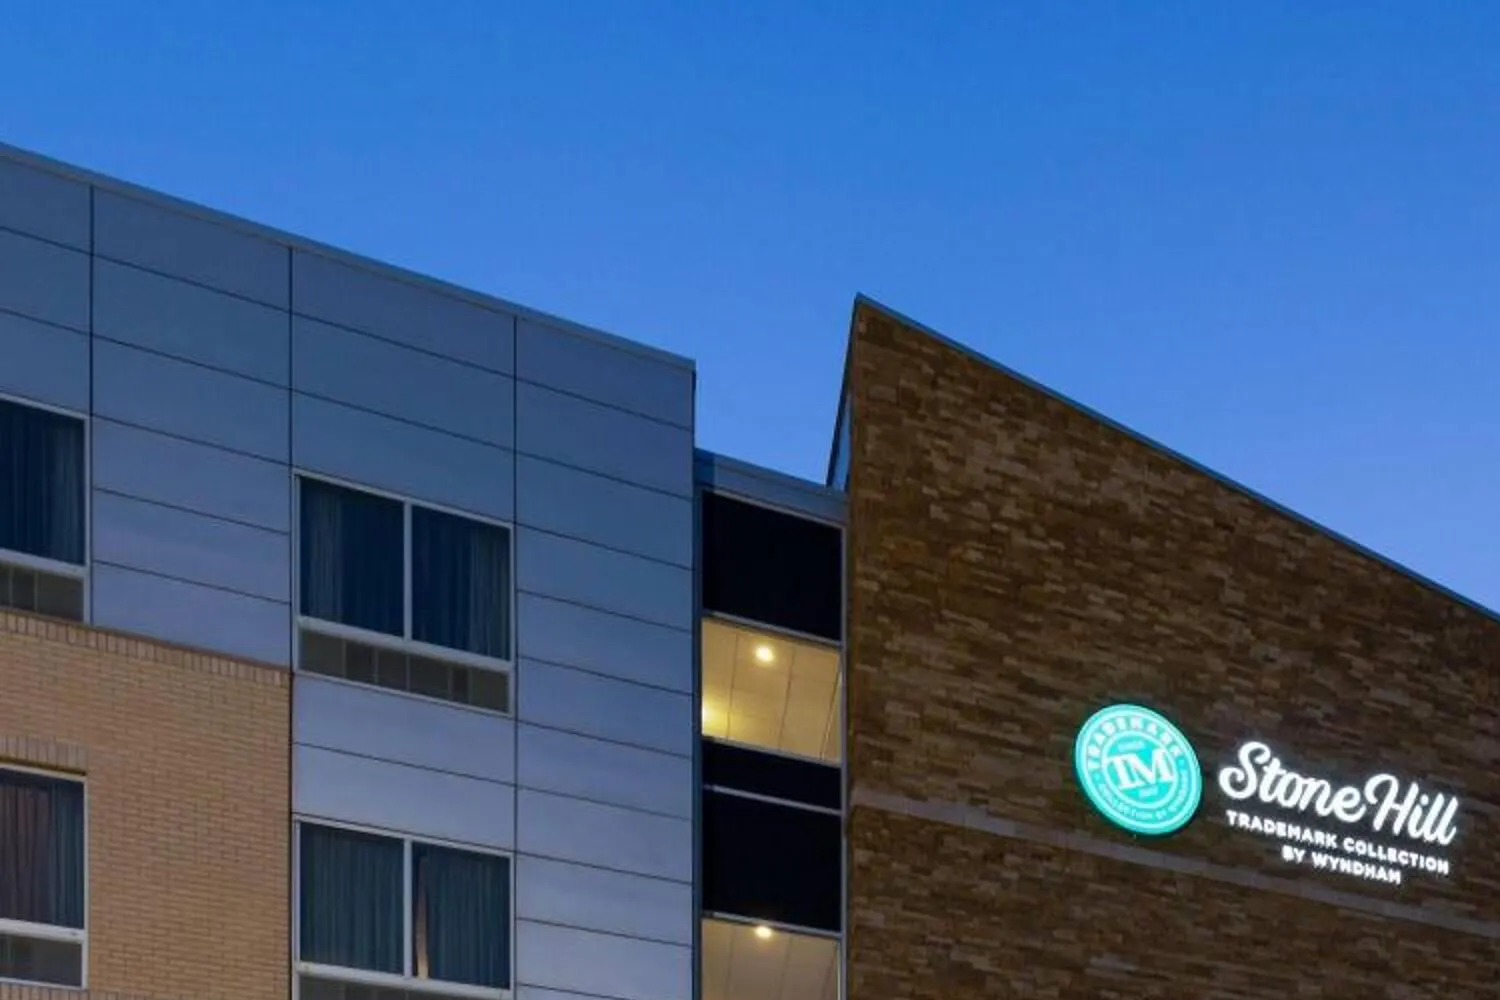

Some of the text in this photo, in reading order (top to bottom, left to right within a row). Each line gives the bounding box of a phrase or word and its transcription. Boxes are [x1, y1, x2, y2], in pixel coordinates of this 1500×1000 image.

[1226, 809, 1449, 875] TRADEMARK COLLECTION
[1281, 845, 1401, 885] BY WYNDHAM
